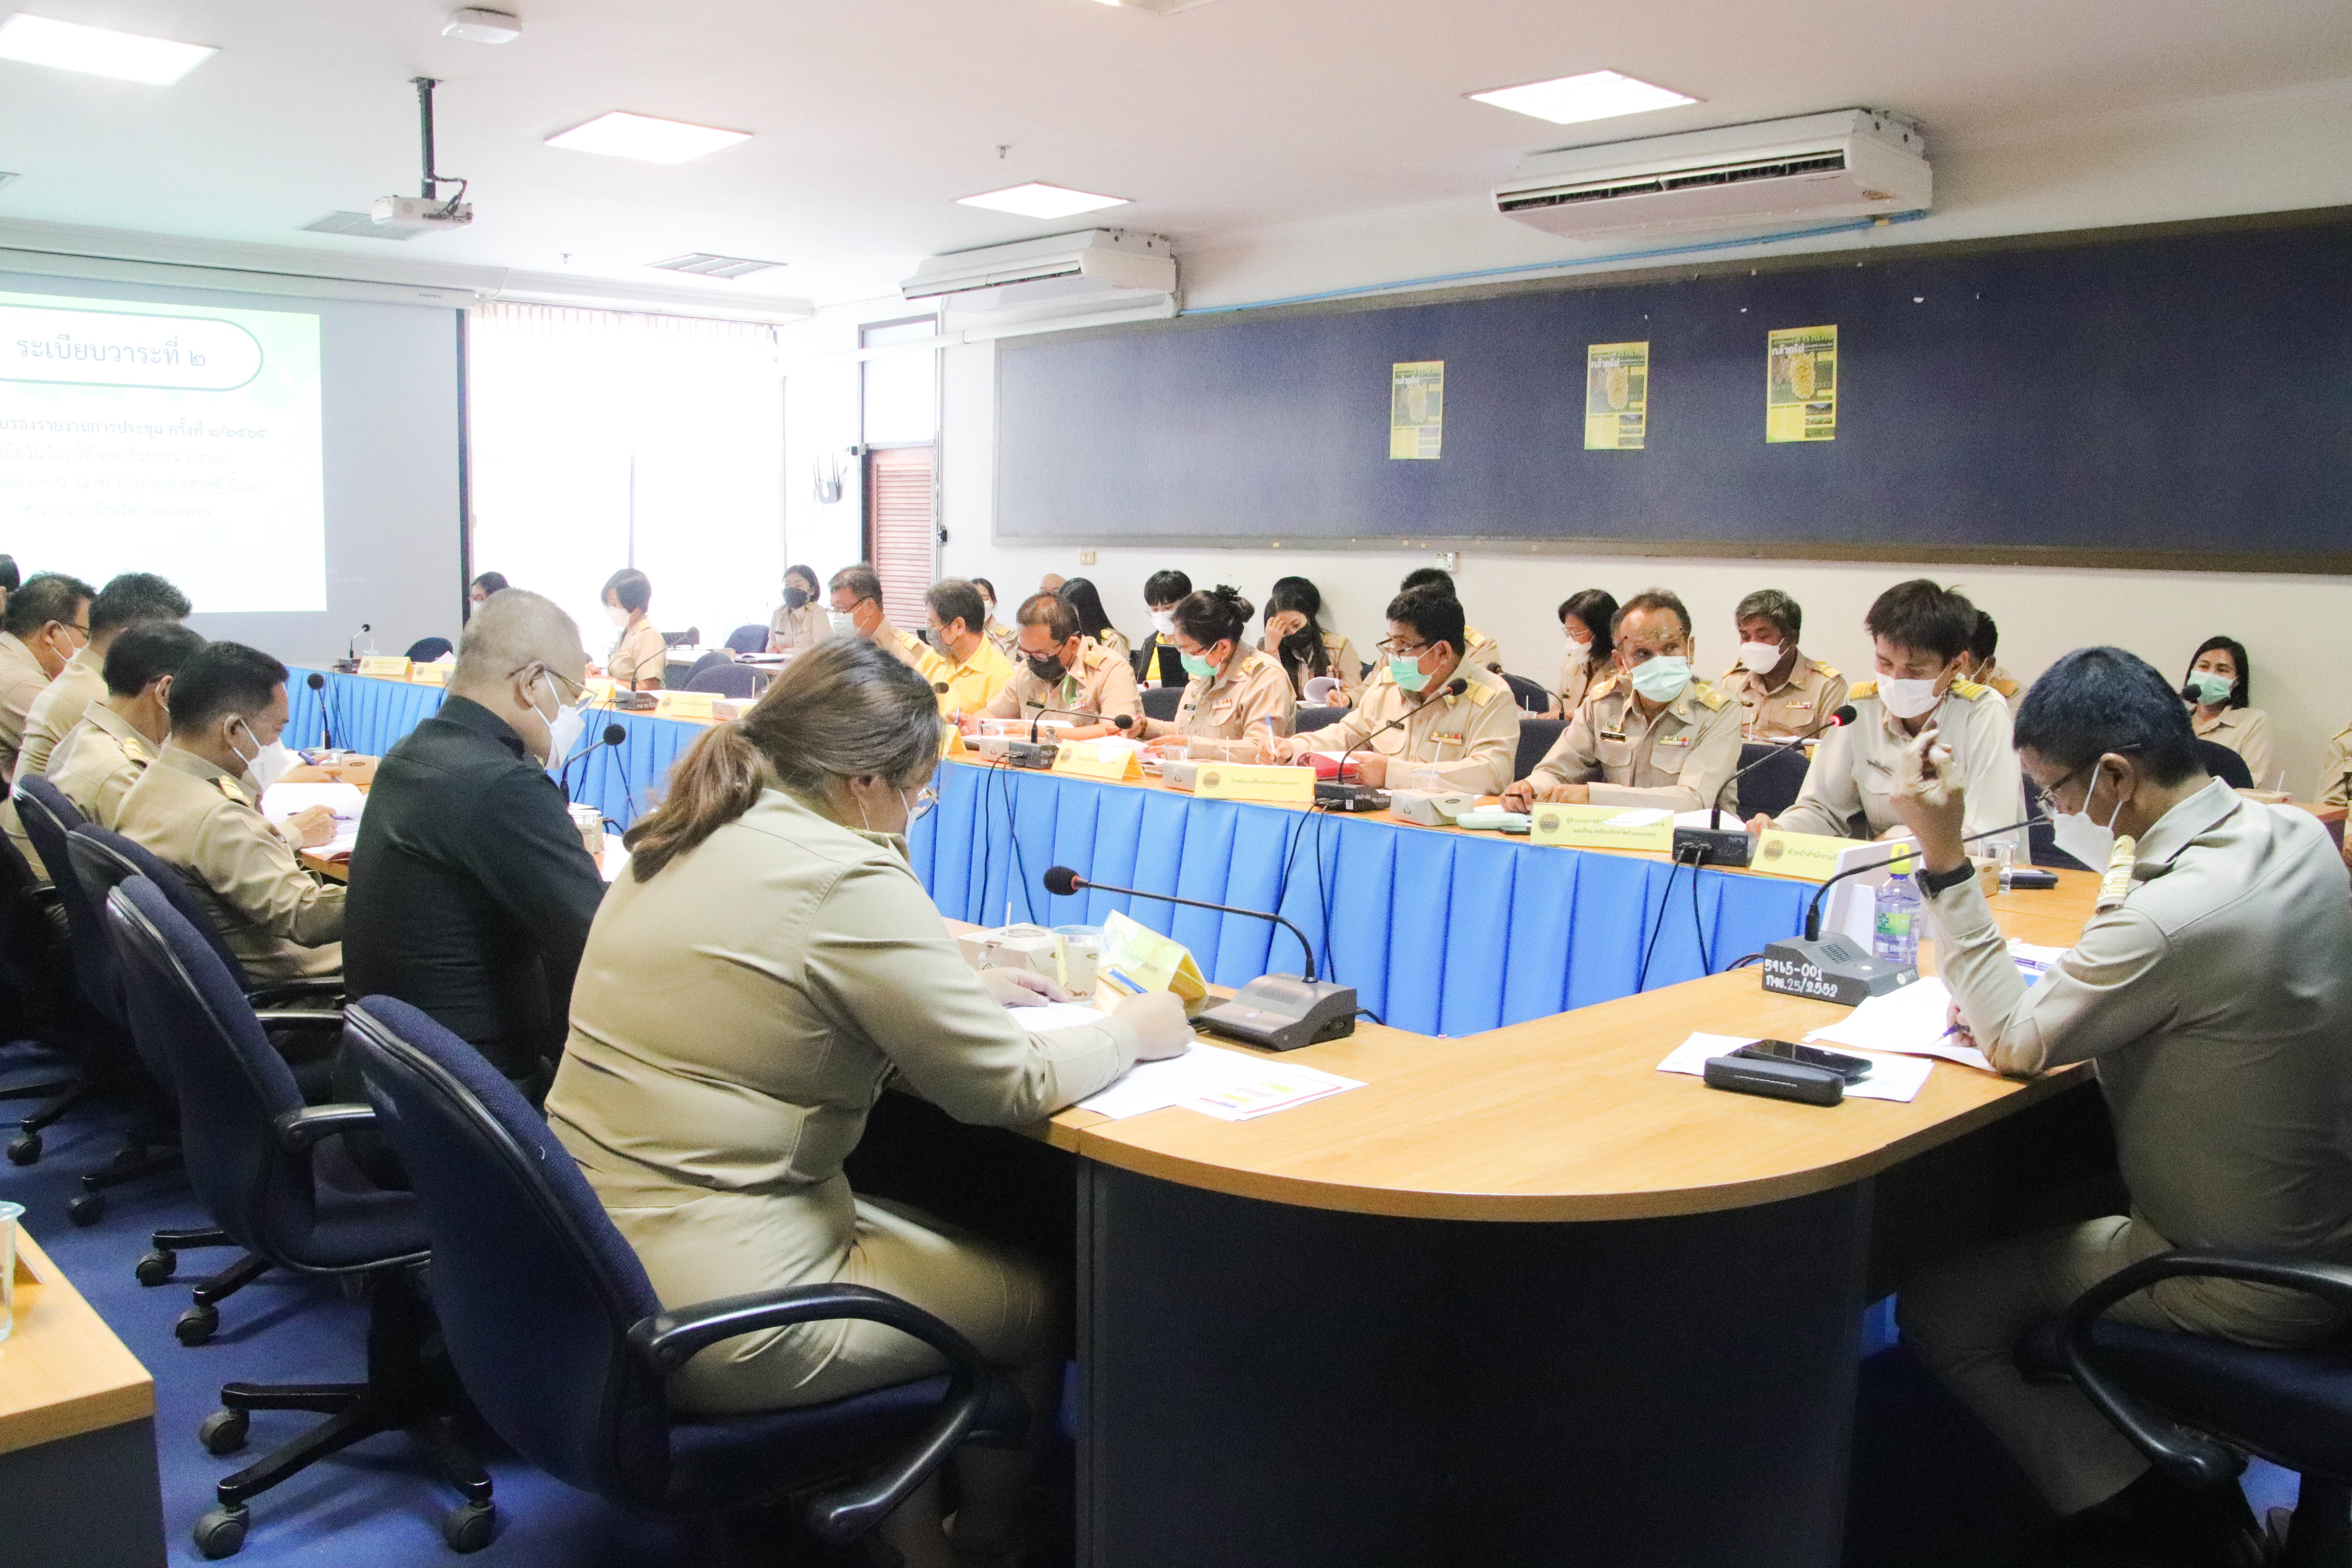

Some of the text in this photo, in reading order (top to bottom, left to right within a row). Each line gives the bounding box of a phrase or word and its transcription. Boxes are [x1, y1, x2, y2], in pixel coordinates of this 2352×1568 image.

[17, 333, 206, 367] ระเบียบวาระที่ ๒
[169, 416, 203, 436] ครั้งที่
